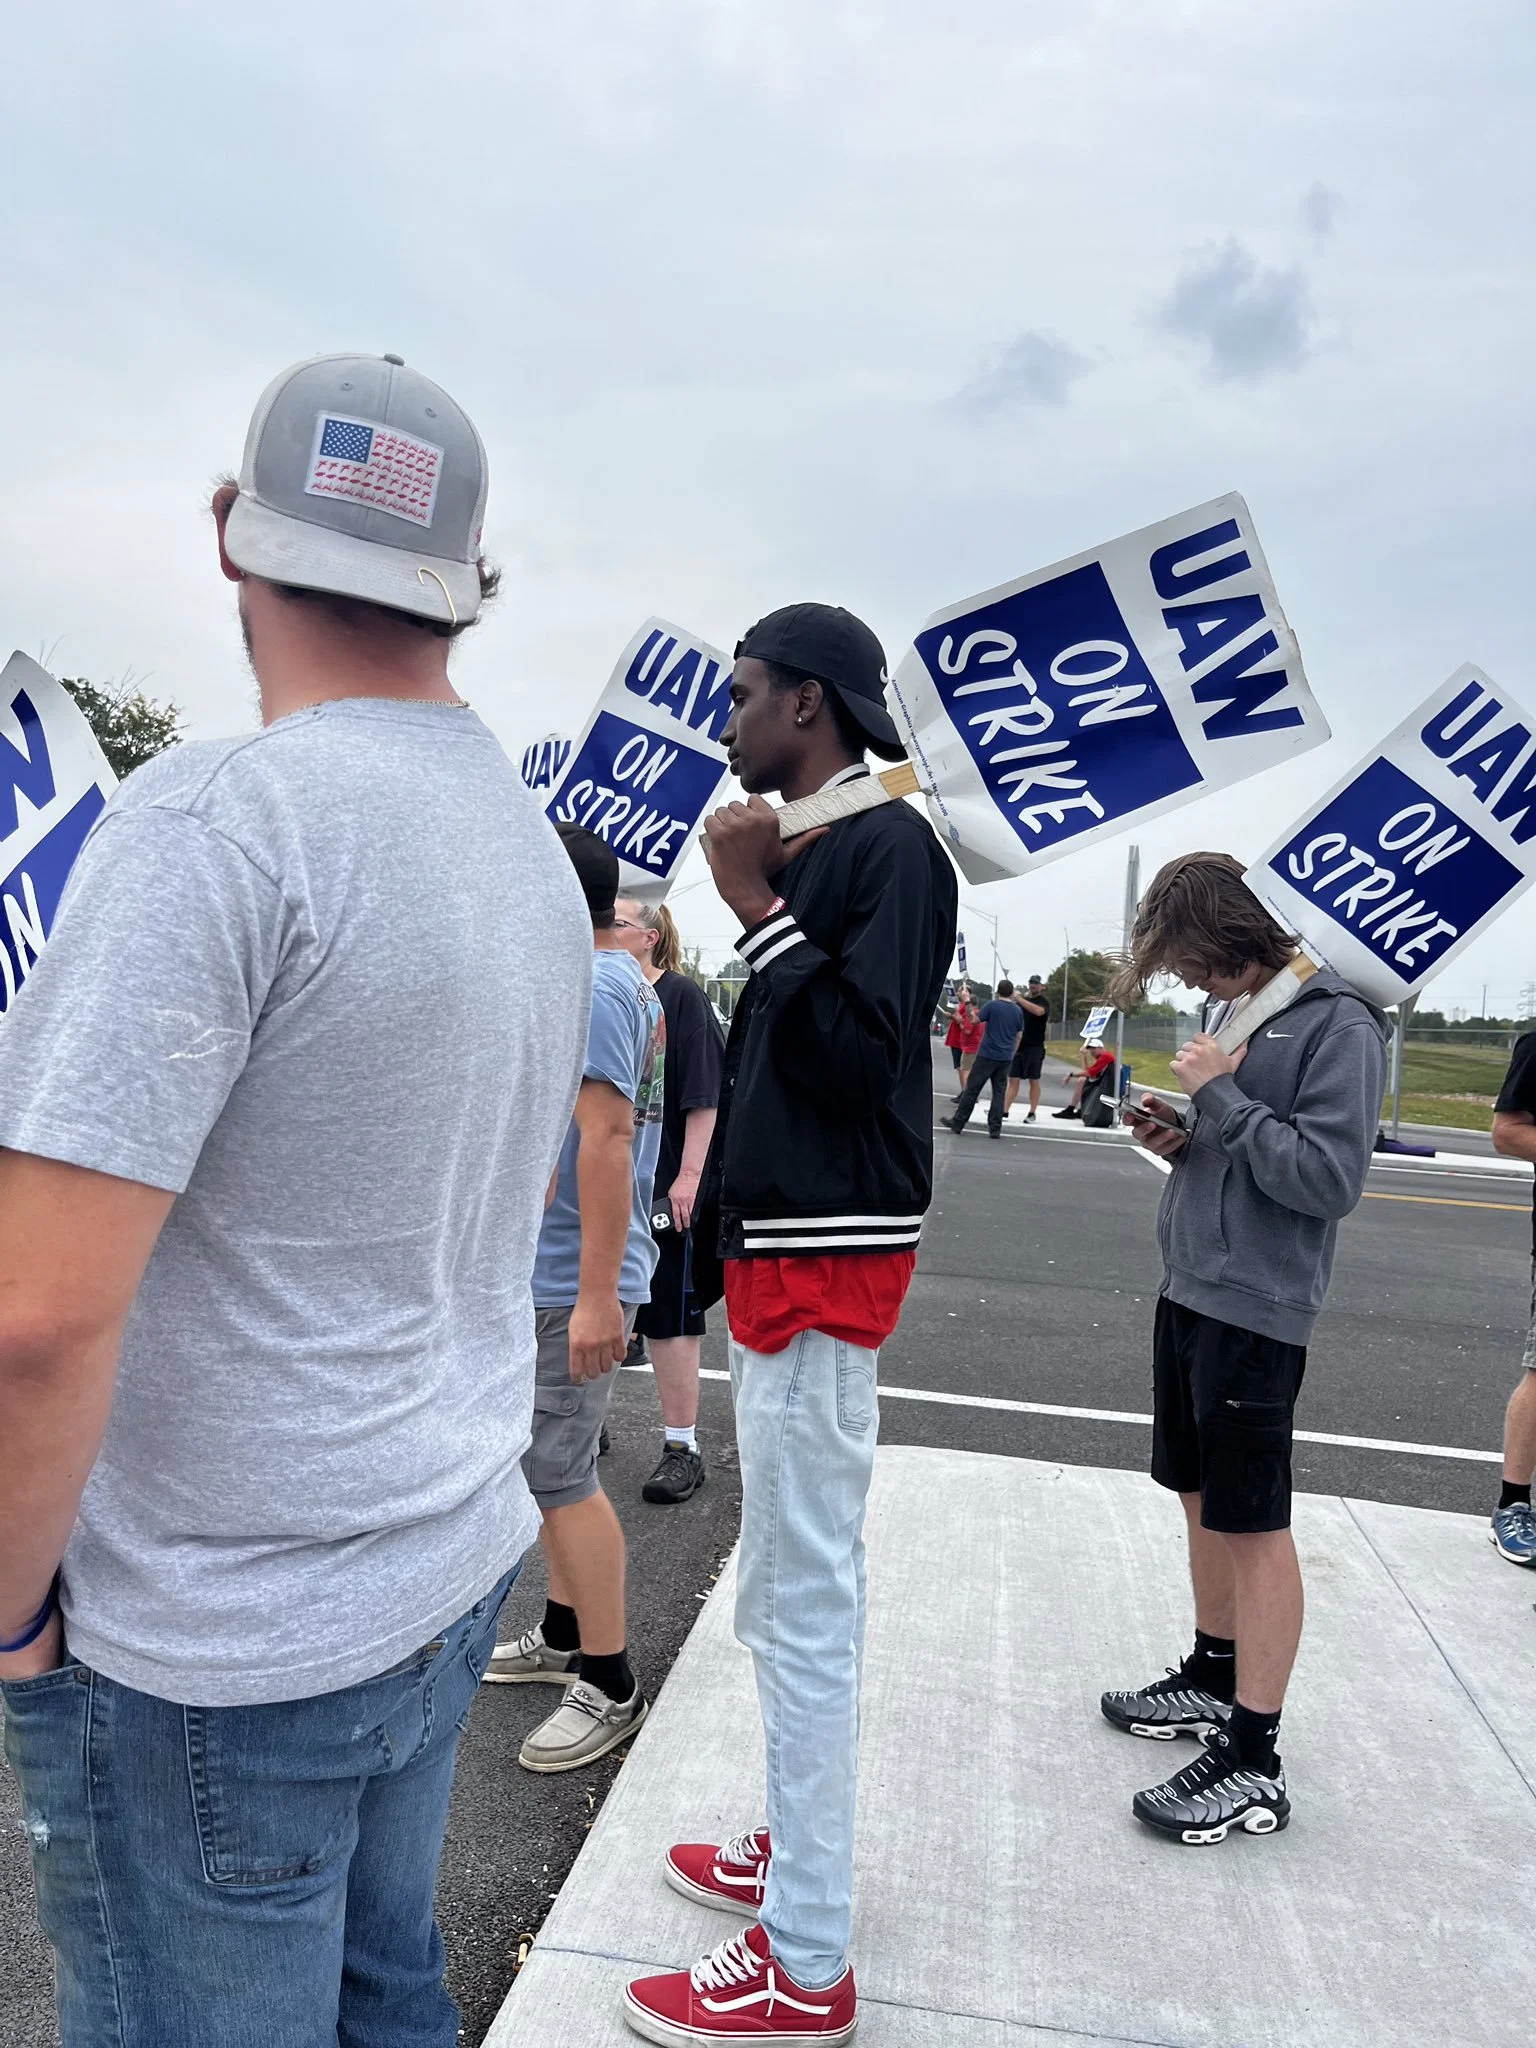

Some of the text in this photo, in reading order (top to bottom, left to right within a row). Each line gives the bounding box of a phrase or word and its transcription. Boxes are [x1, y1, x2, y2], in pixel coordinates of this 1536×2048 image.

[1149, 518, 1305, 741] UAW
[1050, 639, 1158, 728] ON
[612, 733, 679, 793] ON
[938, 629, 1105, 834] STRIKE
[556, 779, 688, 865] STRIKE
[1378, 802, 1471, 876] ON
[1288, 832, 1458, 968] STRIKE
